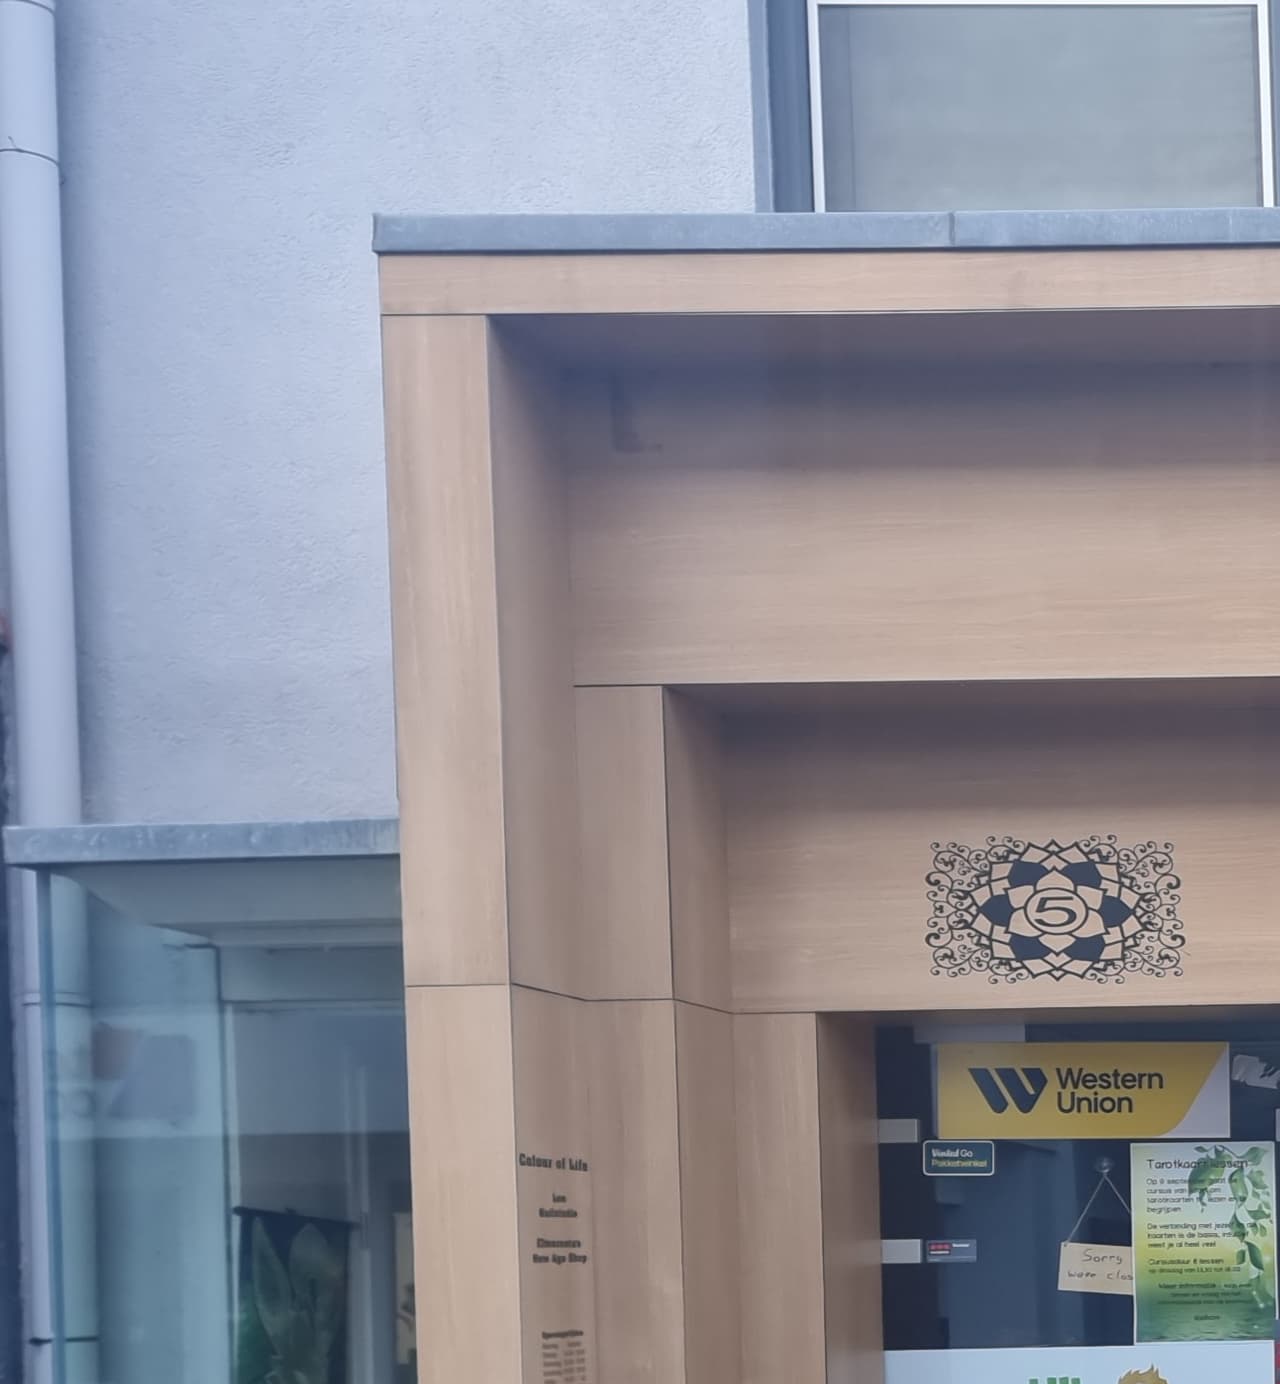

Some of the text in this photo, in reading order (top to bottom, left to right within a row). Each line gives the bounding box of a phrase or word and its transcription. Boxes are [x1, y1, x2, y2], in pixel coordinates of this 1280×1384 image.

[1035, 896, 1077, 927] 5
[1055, 1067, 1164, 1090] Western
[1056, 1092, 1133, 1114] Union
[960, 1149, 973, 1158] Go
[1082, 1248, 1122, 1265] Sorry
